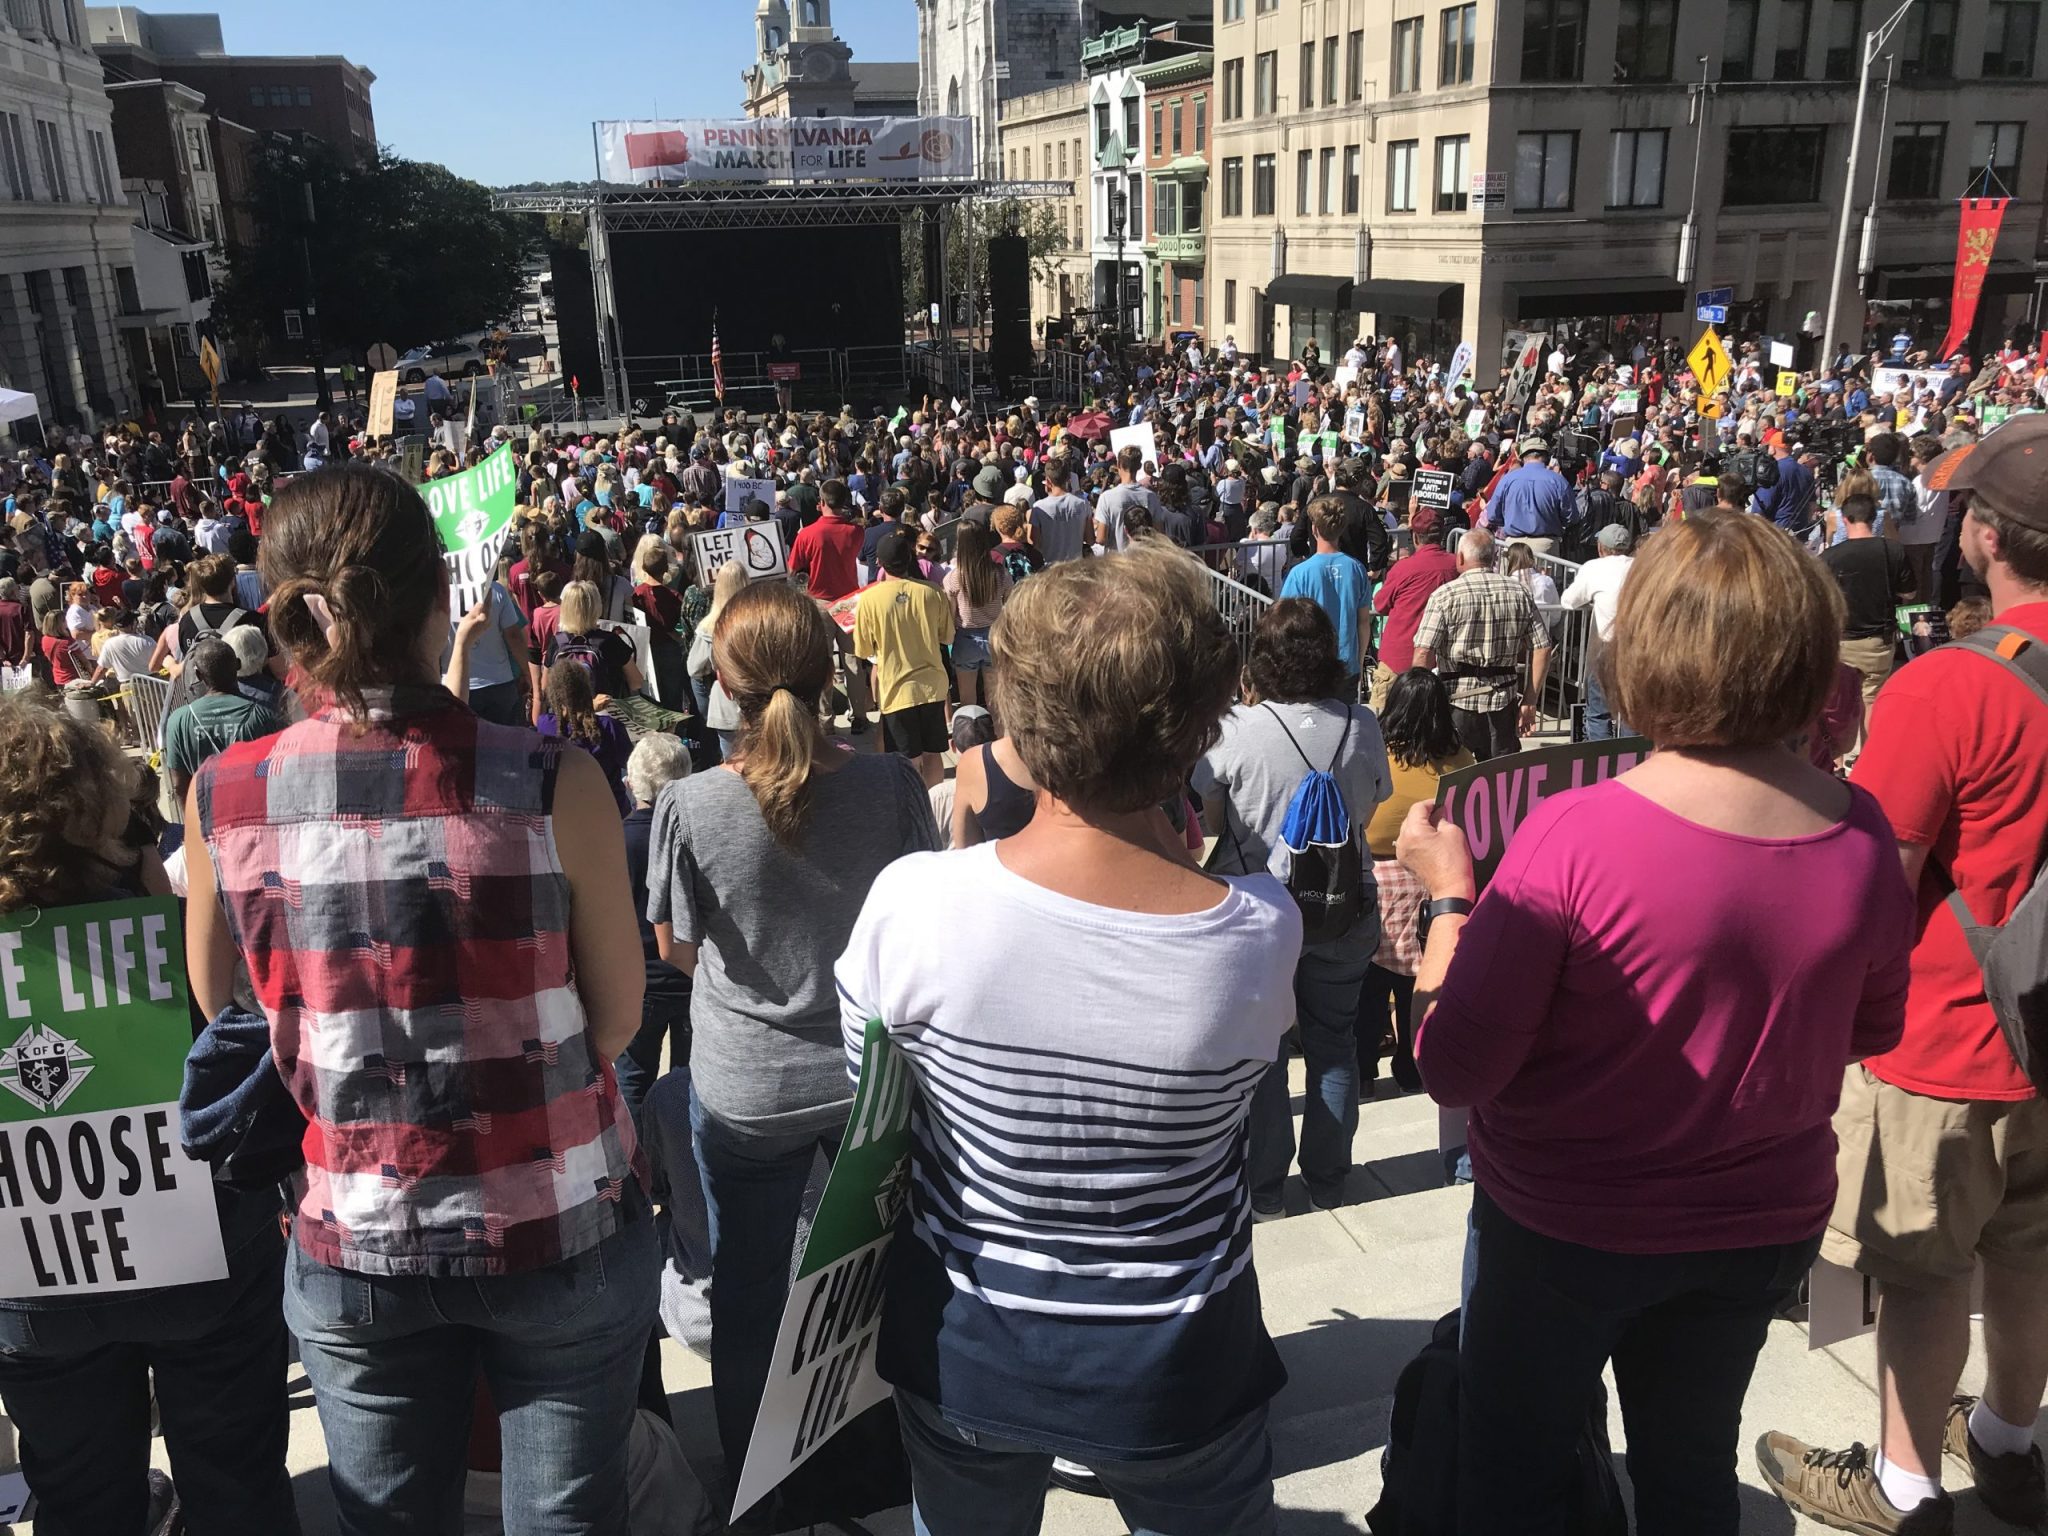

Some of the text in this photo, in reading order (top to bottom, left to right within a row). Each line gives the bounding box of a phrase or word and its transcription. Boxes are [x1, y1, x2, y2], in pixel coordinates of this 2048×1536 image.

[704, 127, 873, 147] PENNSYLVANIA
[715, 150, 866, 169] MARCH FOR LIFE
[1700, 306, 1715, 319] State
[424, 453, 512, 518] OVE LIFE
[1421, 484, 1441, 492] ANTI-
[1414, 490, 1448, 502] ABORTION
[703, 533, 733, 552] LET
[1303, 890, 1324, 898] HOLY
[1326, 892, 1346, 902] SPIRIT
[54, 914, 173, 1012] LIFE
[17, 1042, 65, 1060] K OF C
[20, 1207, 137, 1287] LIFE
[791, 1243, 893, 1376] CHOO
[790, 1330, 873, 1463] LIFE
